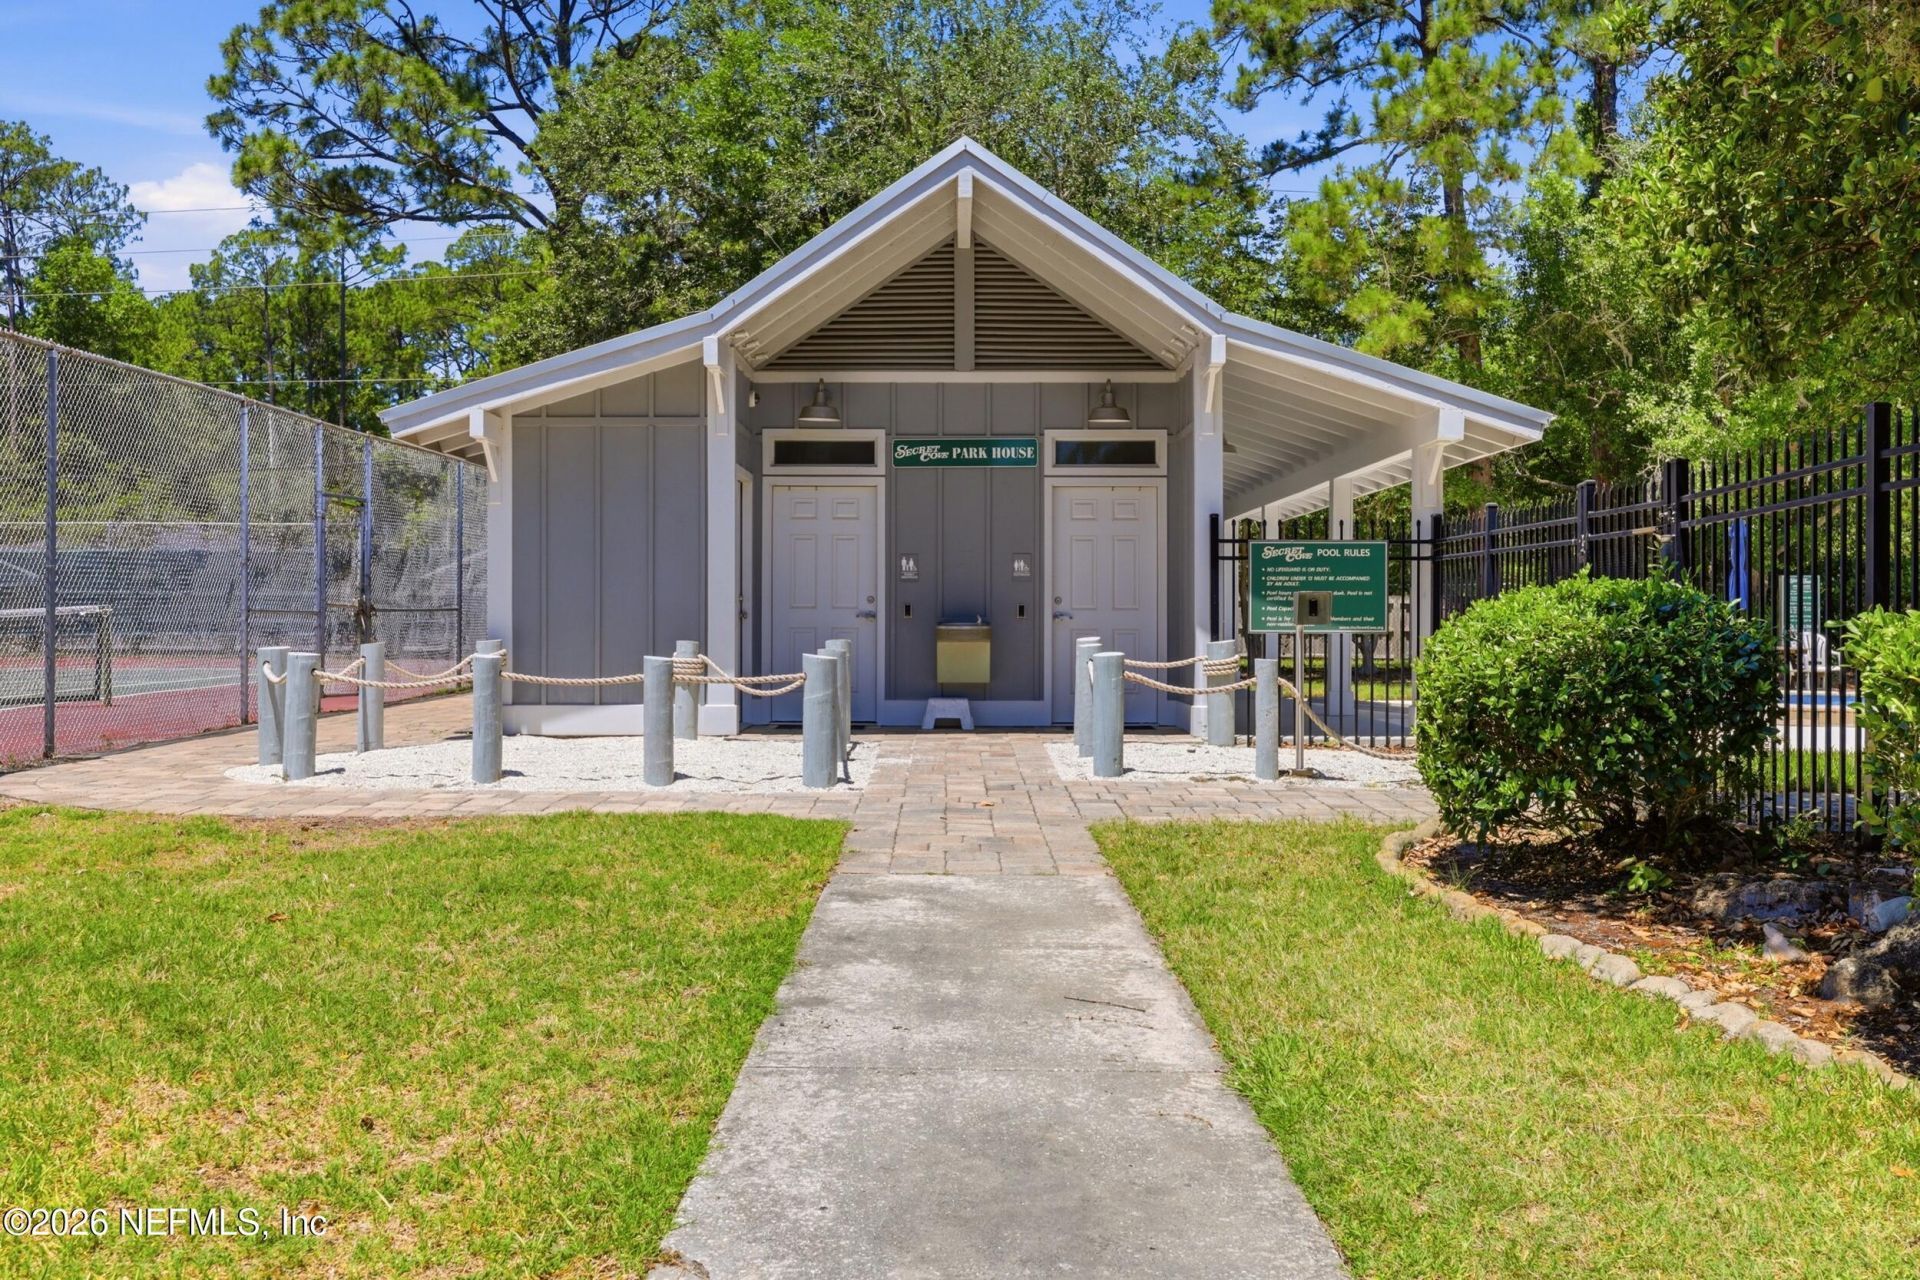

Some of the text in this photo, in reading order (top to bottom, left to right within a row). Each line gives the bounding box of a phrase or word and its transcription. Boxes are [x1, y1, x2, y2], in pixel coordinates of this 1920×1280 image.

[895, 445, 1035, 462] SECRET COVE PARK HOUSE
[1261, 546, 1371, 562] SECRET COVE POOL RULES
